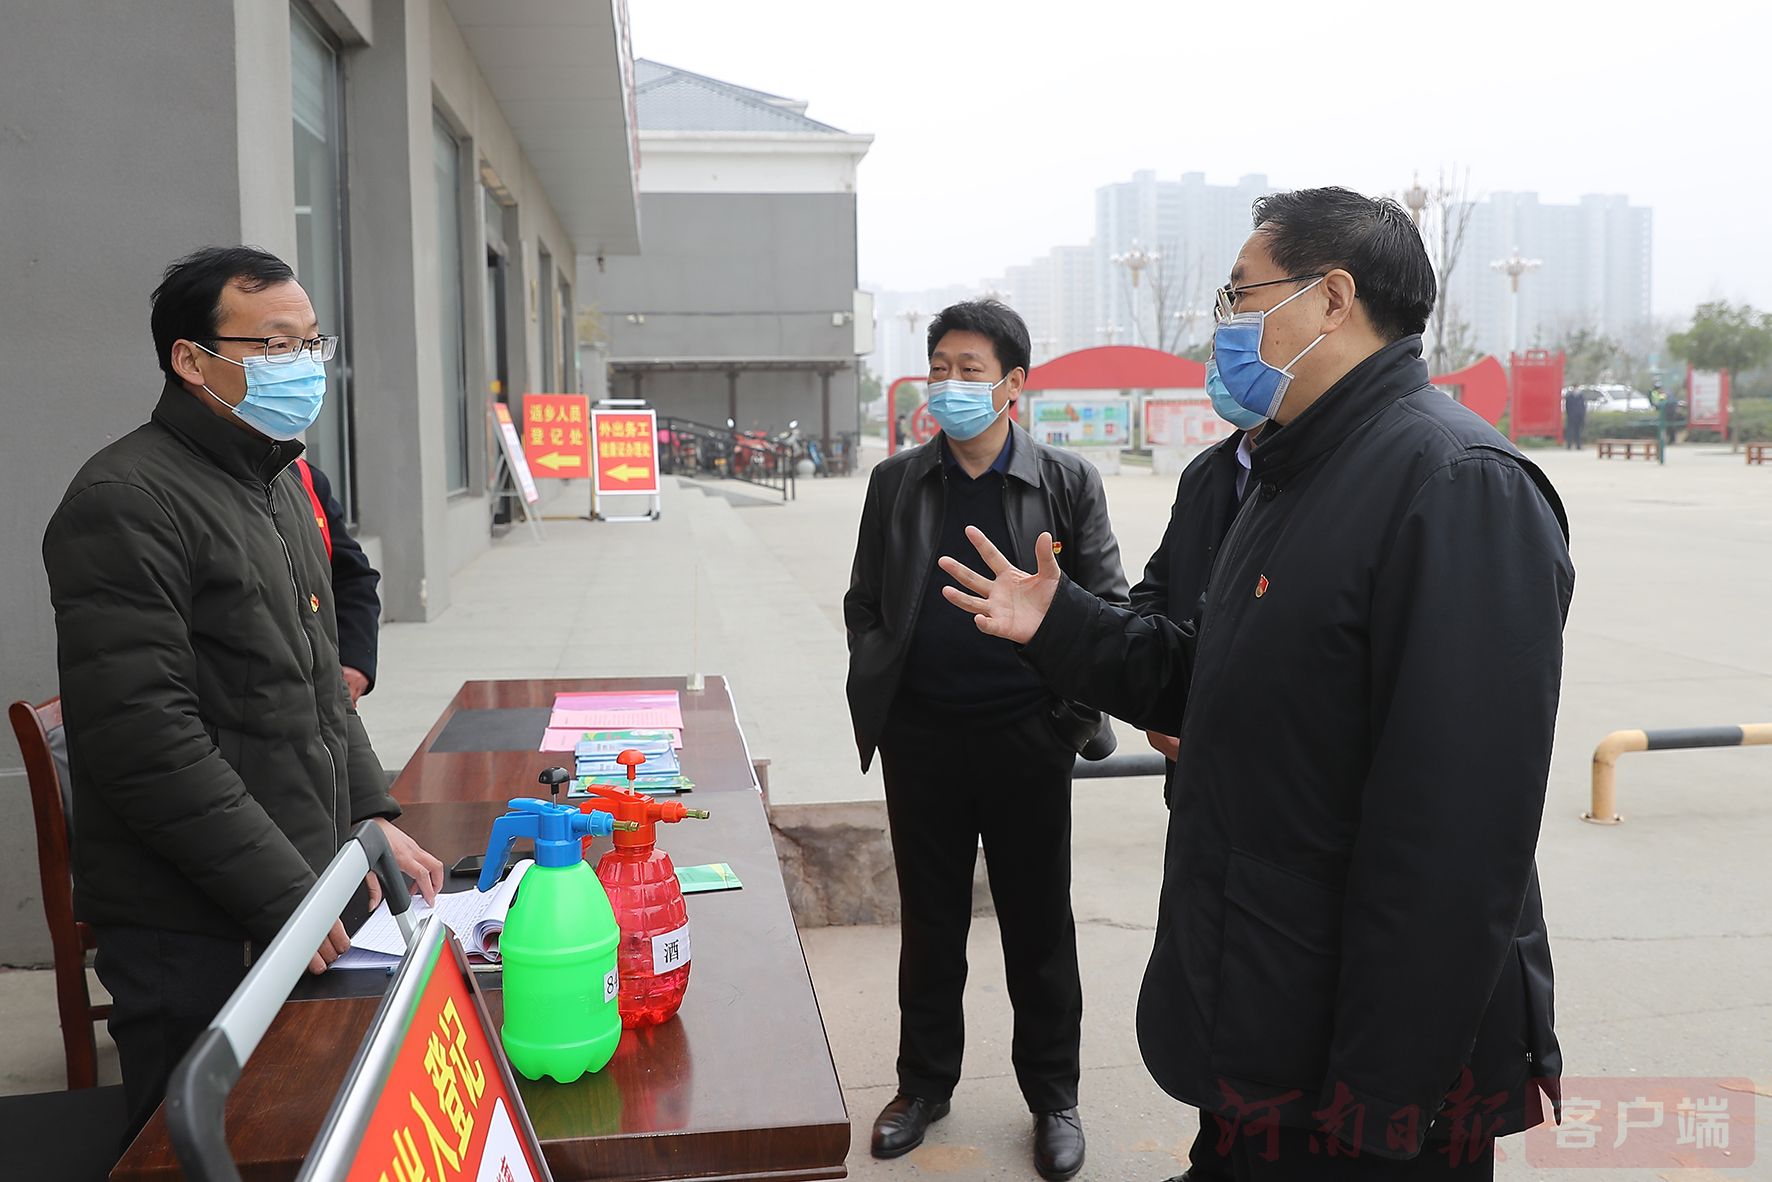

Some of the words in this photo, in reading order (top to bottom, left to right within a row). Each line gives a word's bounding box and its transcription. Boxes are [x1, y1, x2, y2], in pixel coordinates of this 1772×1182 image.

[530, 404, 582, 423] 返乡人员
[530, 427, 583, 446] 登记处
[599, 421, 649, 438] 外出务工
[663, 939, 679, 963] 酒
